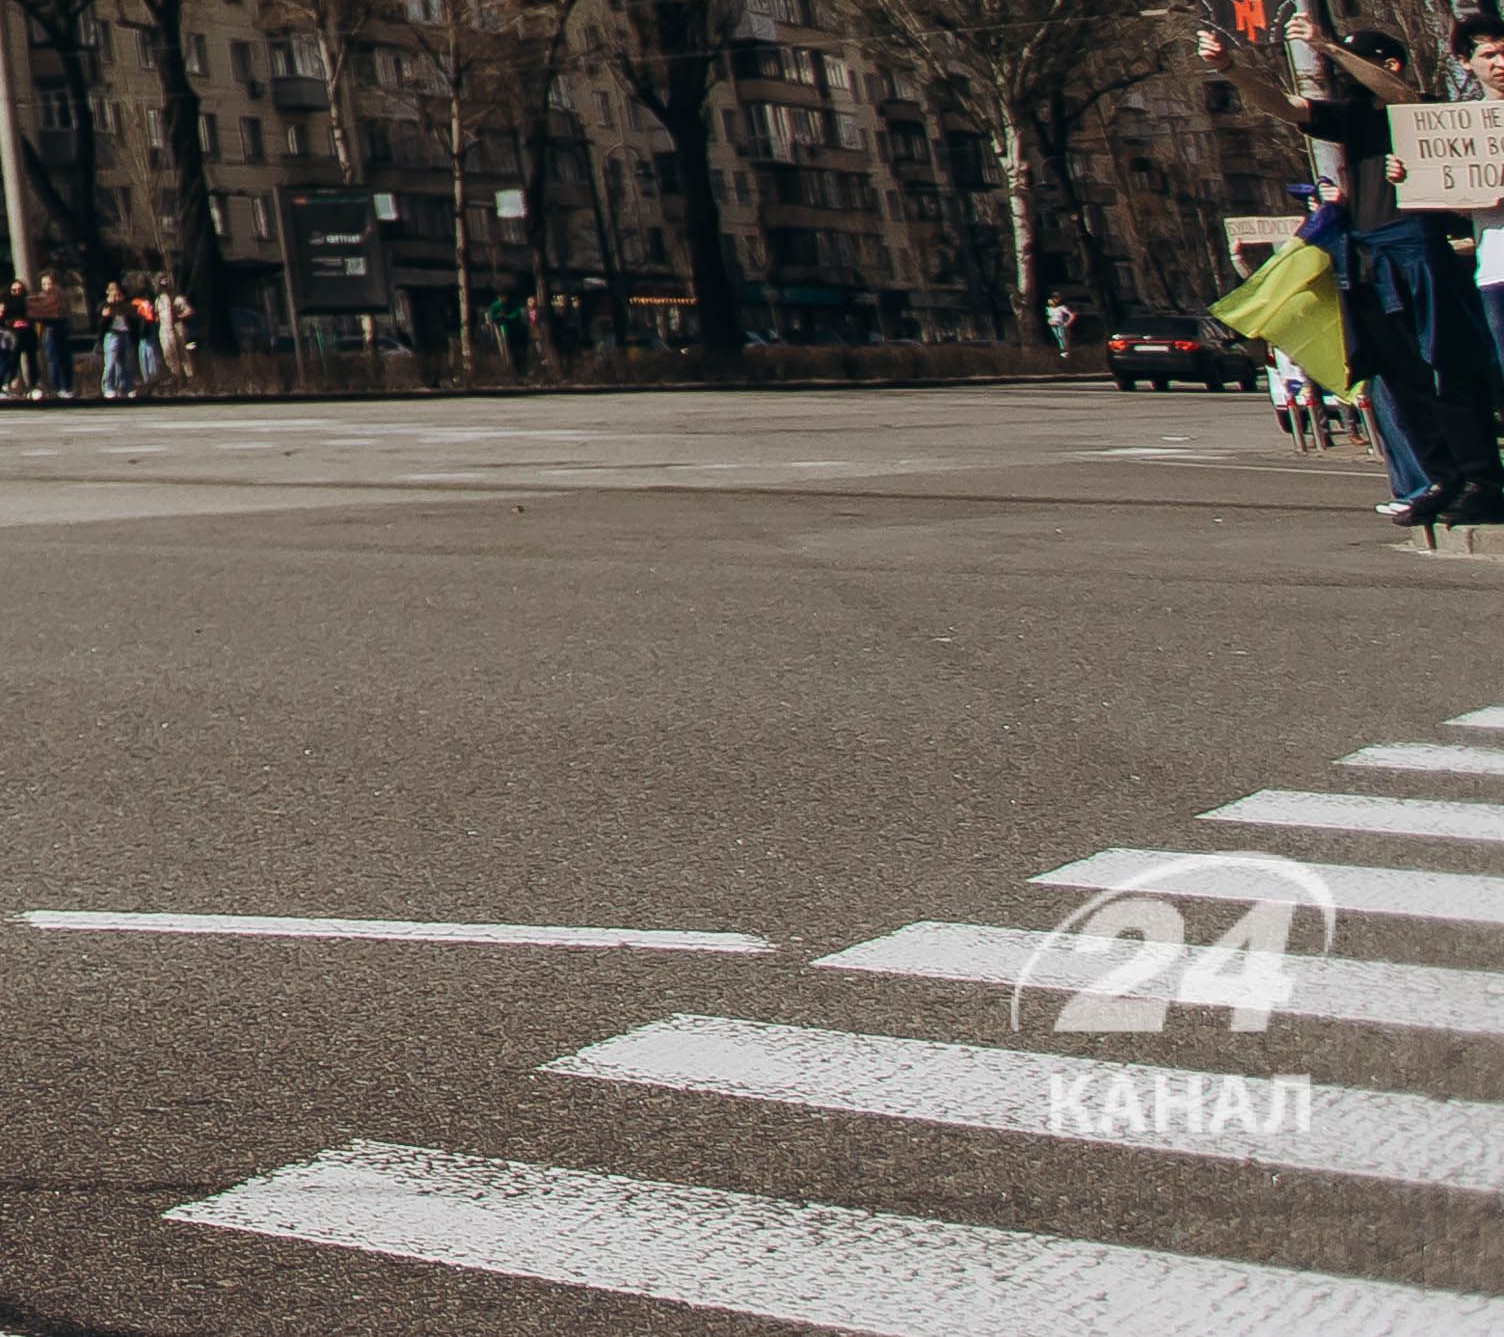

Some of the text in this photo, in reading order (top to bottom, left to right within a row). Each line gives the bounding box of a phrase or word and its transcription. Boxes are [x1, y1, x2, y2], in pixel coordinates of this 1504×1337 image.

[1414, 107, 1503, 131] НІХТО НЕ
[1418, 137, 1476, 159] ПОКИ
[1443, 164, 1455, 189] В
